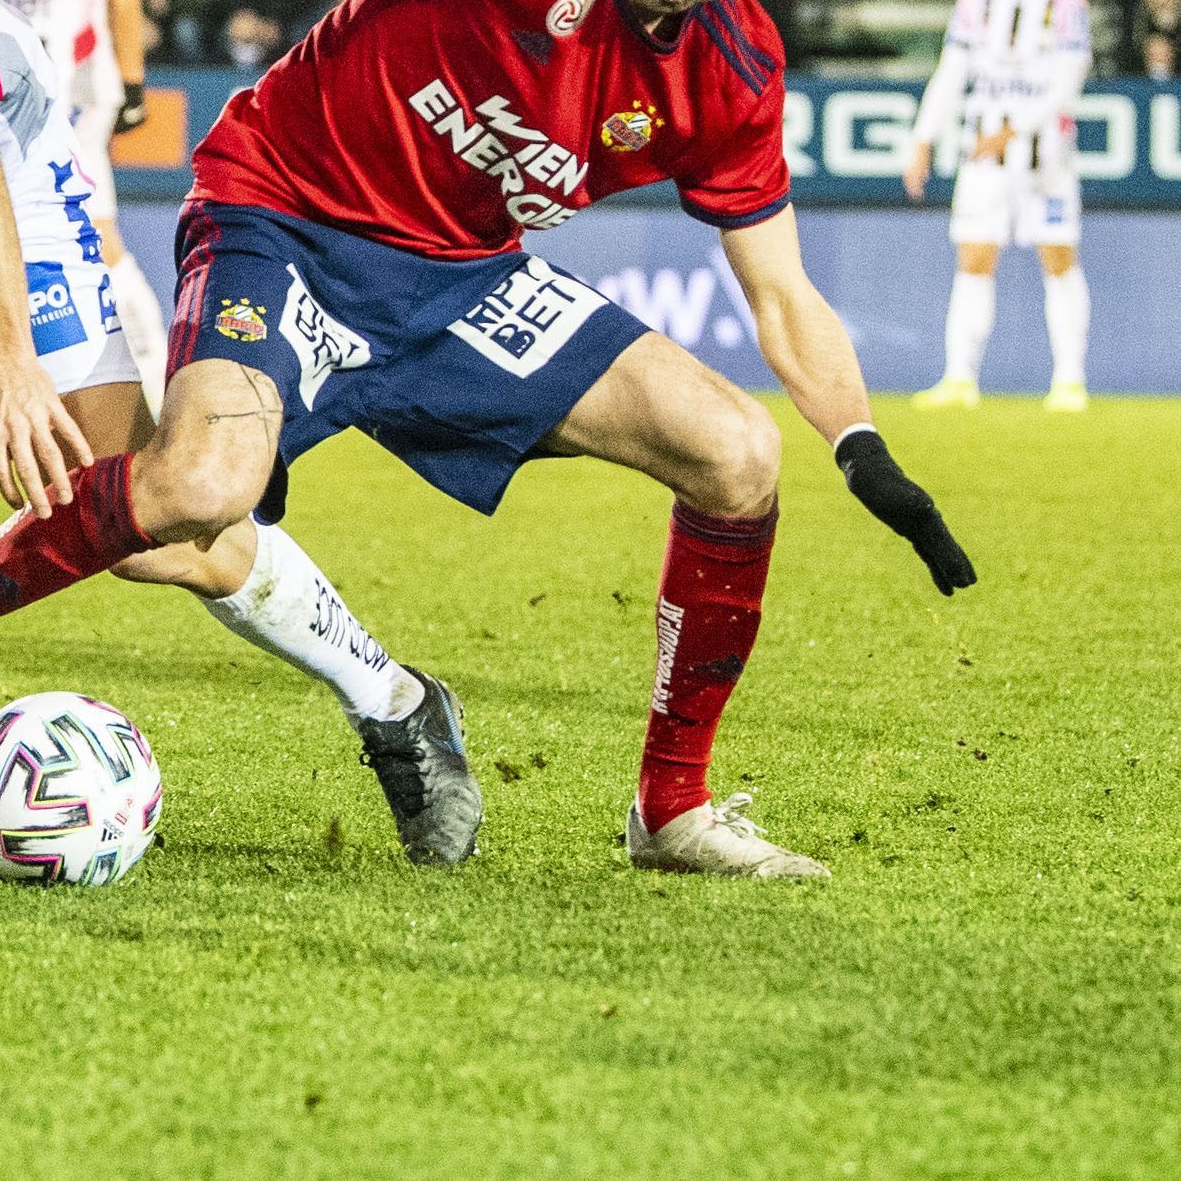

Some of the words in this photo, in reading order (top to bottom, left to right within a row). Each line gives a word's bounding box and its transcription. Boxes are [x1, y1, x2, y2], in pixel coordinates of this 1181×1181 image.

[407, 78, 579, 230] ENERGIE
[474, 94, 590, 196] WIEN
[28, 283, 69, 317] PO
[489, 279, 577, 360] BET
